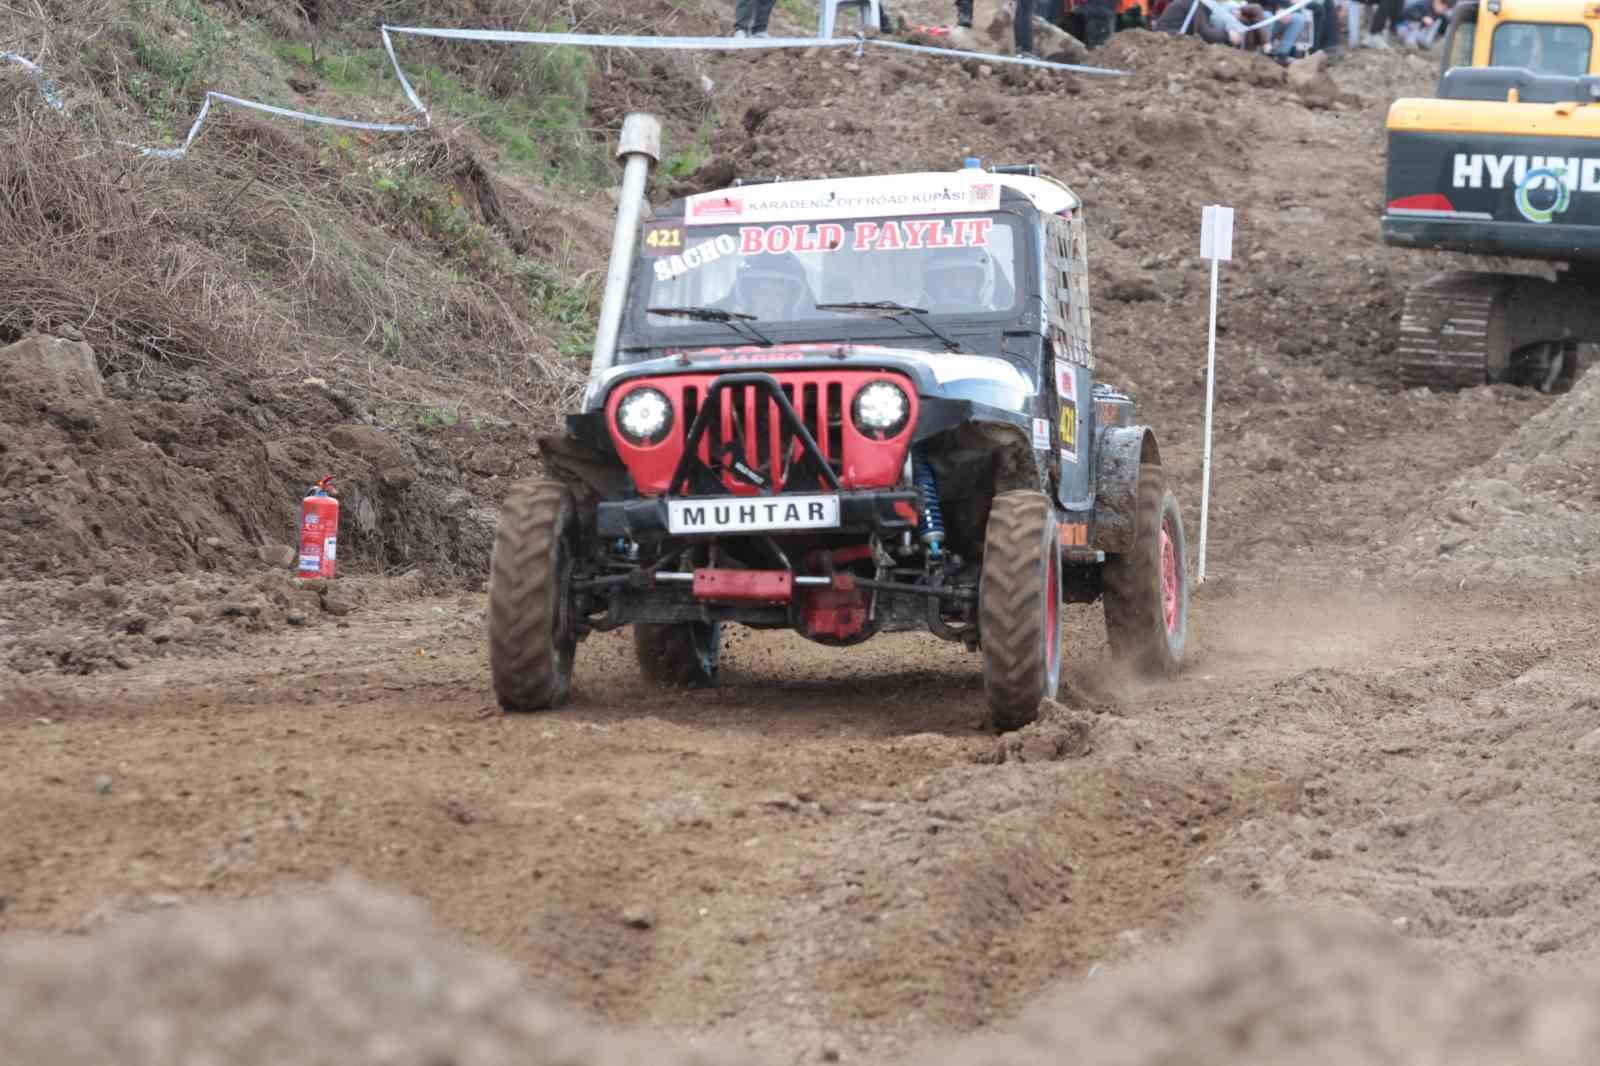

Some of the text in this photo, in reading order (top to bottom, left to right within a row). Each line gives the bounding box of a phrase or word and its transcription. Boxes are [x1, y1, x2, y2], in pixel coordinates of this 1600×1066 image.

[646, 229, 681, 248] 421
[740, 219, 992, 255] BOLD PAYLIT
[653, 234, 736, 281] SACHO
[683, 501, 825, 526] MUHTAR
